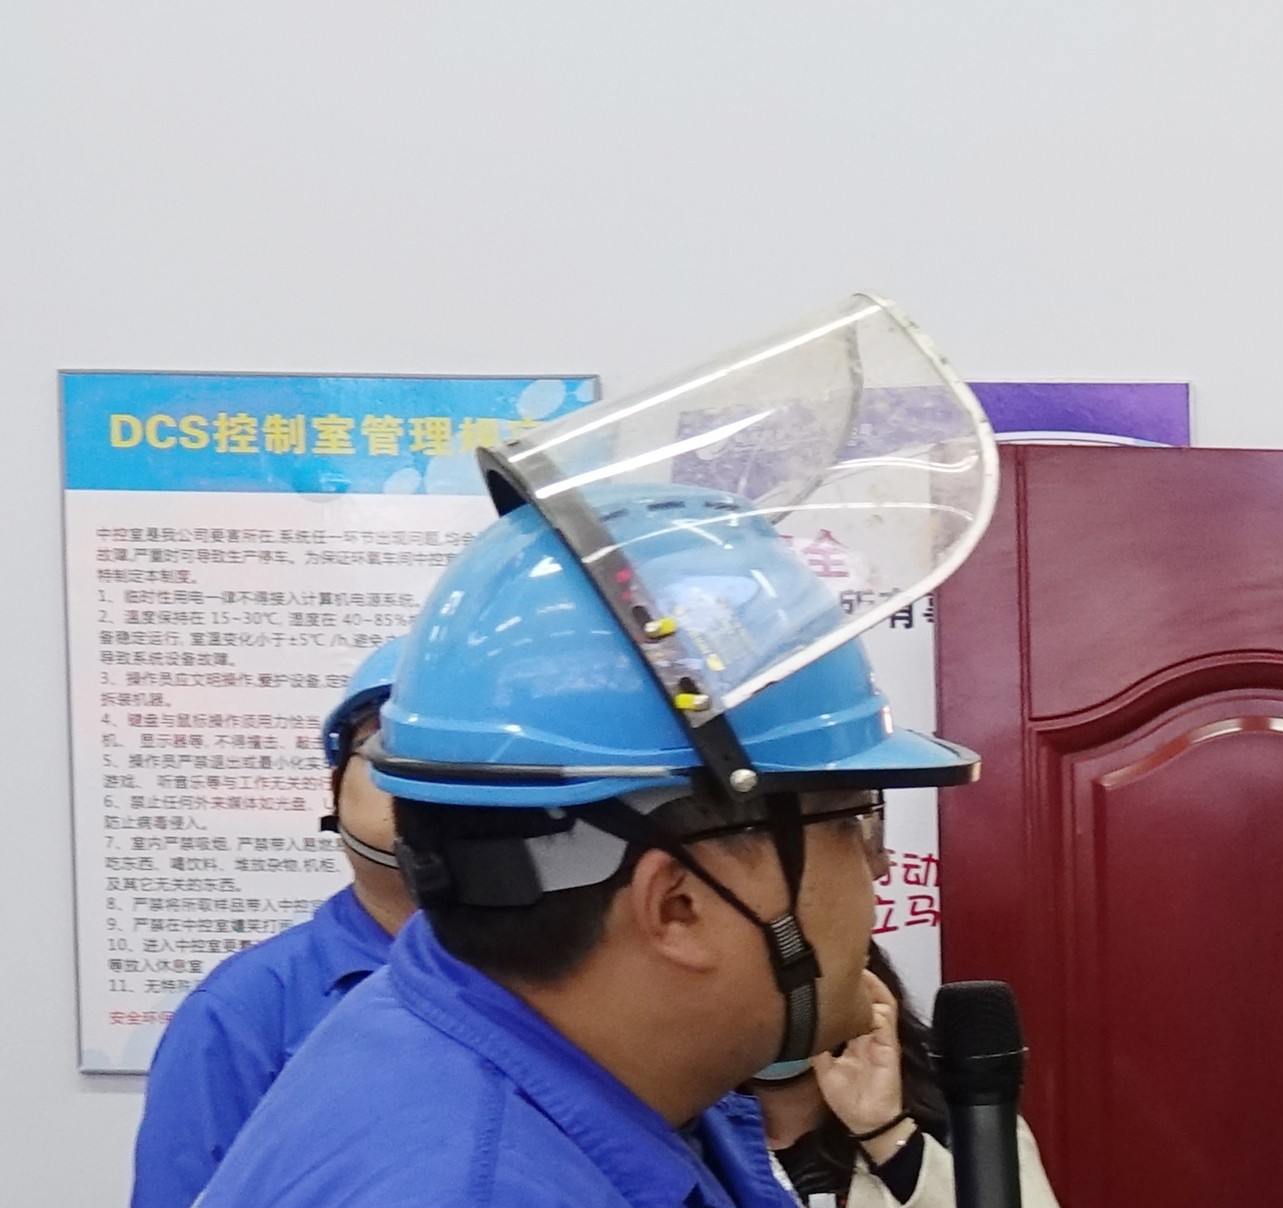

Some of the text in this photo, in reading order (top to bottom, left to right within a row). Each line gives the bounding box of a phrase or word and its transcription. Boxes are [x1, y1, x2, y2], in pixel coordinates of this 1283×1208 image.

[109, 413, 547, 457] DCS控制室管理规
